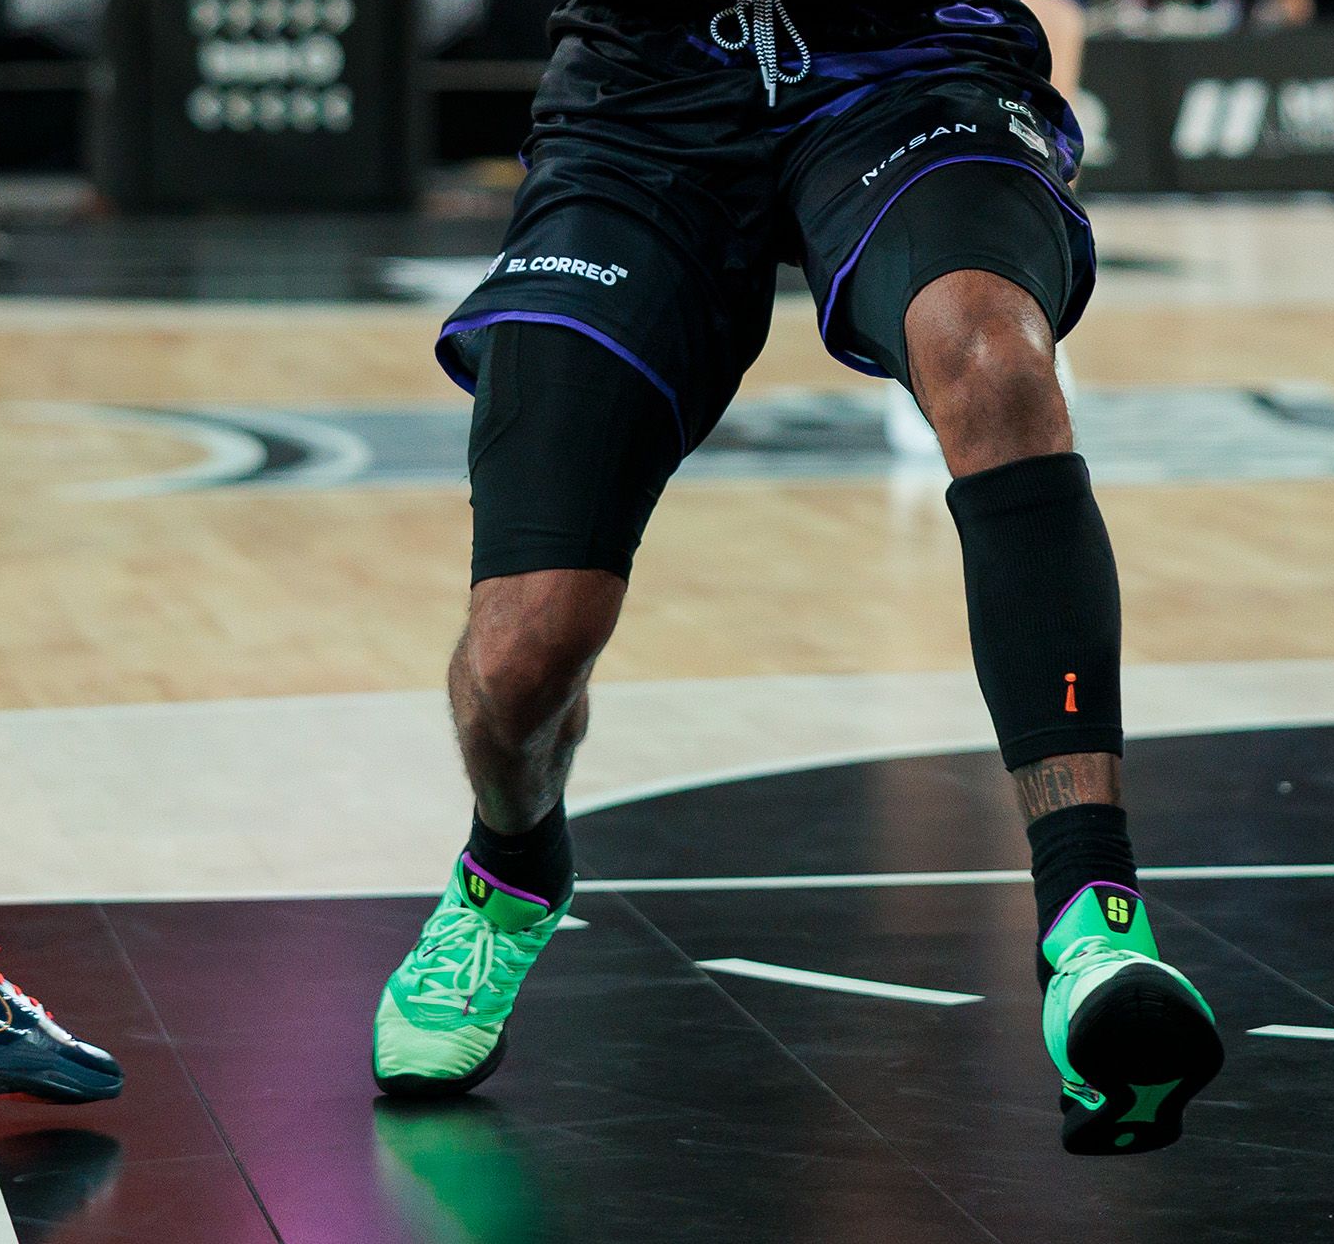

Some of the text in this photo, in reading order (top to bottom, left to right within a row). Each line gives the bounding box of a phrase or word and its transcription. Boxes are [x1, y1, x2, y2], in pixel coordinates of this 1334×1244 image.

[862, 123, 977, 186] NISSAN
[506, 256, 617, 286] EL CORREO
